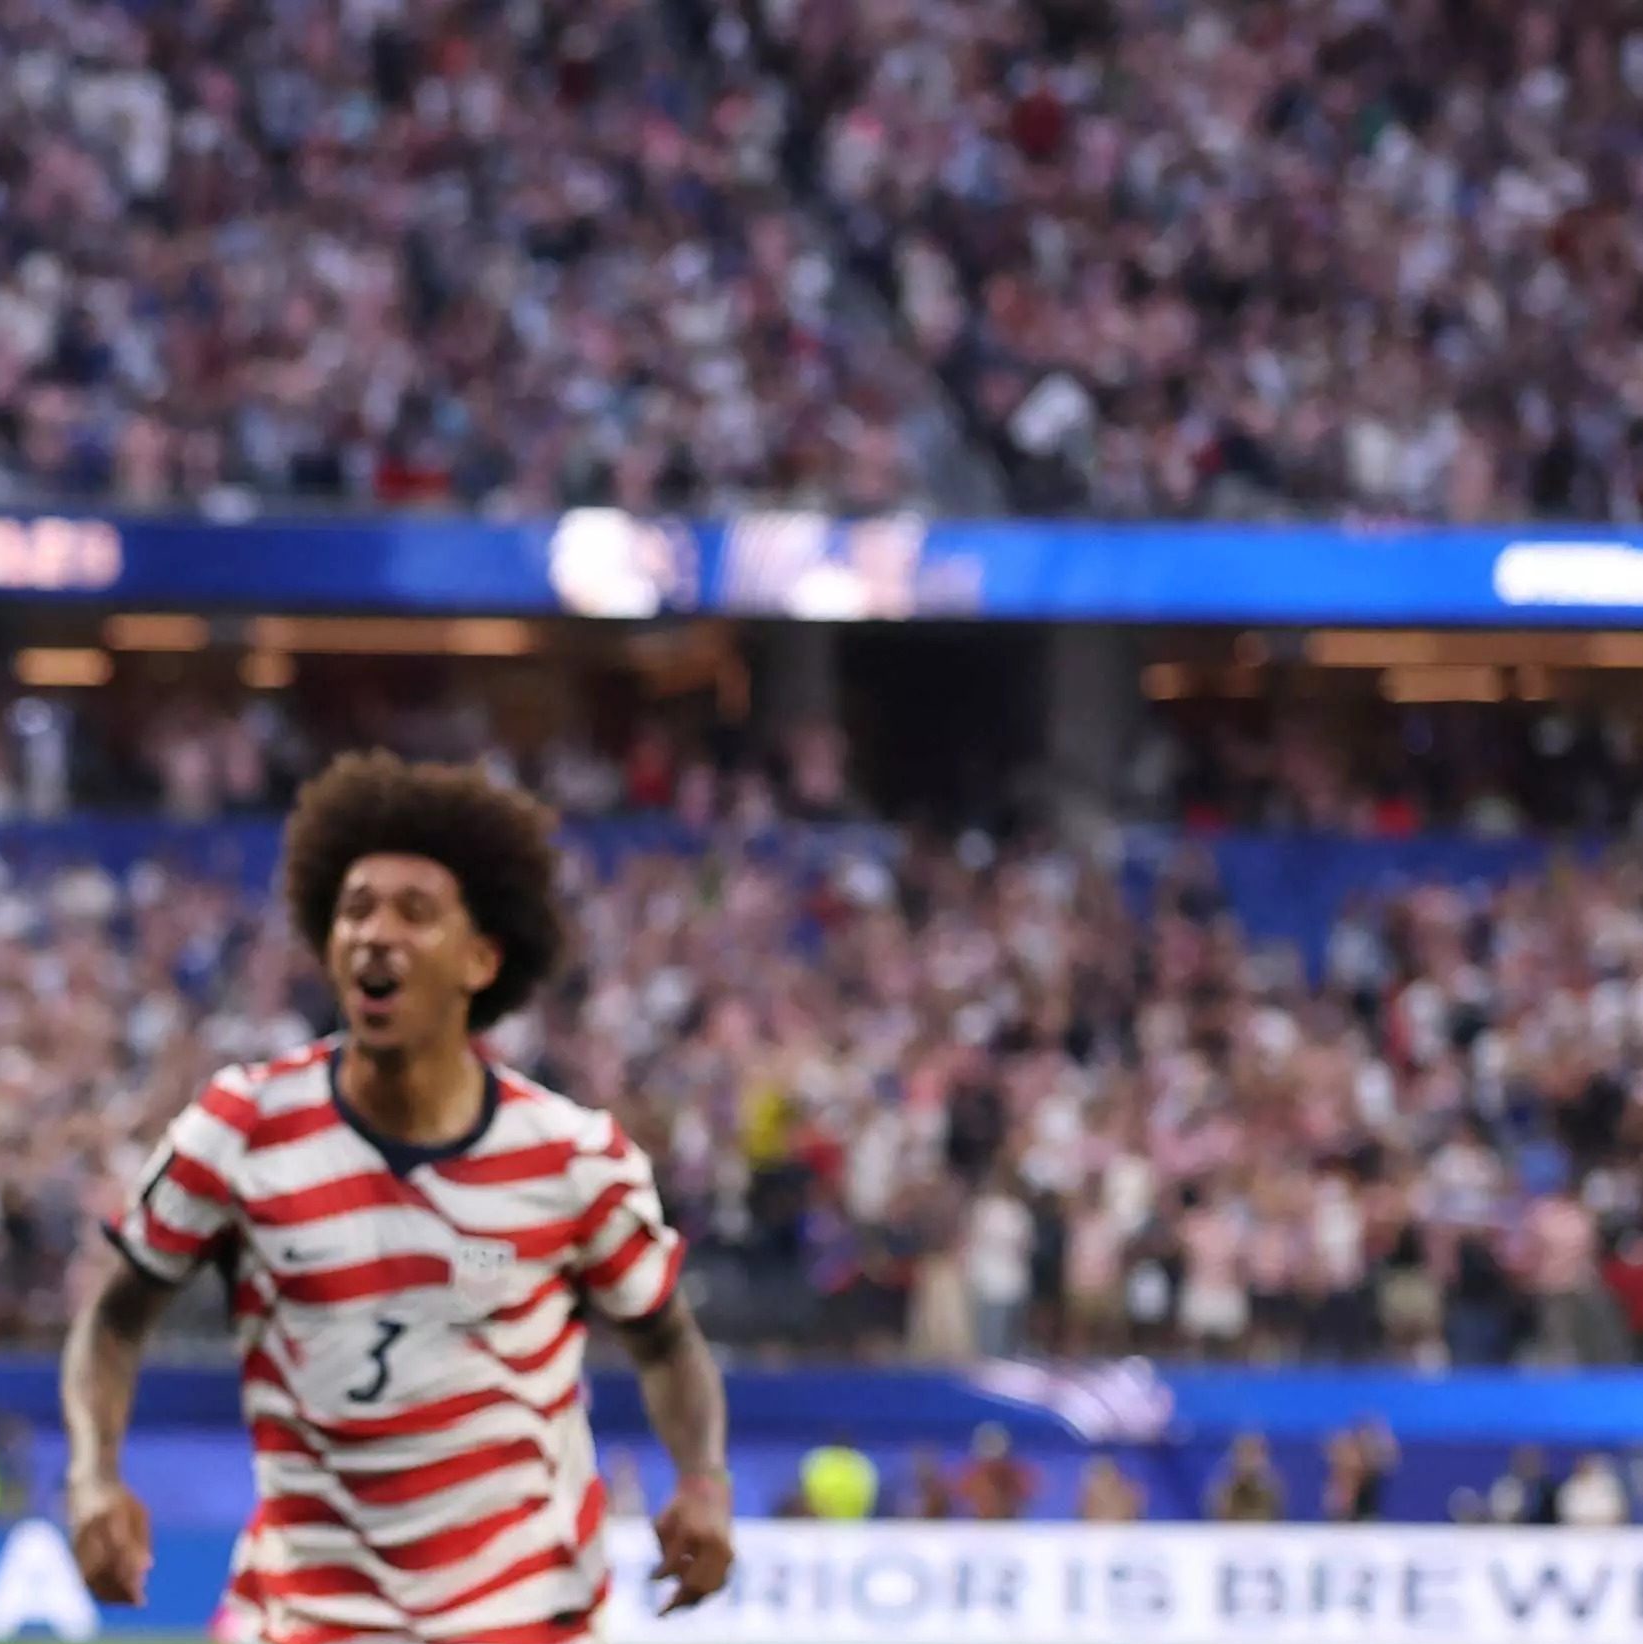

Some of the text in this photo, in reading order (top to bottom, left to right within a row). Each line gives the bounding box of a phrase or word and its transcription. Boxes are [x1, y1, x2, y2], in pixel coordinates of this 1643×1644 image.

[345, 1318, 409, 1404] 3
[644, 1553, 1028, 1624] RIOR
[1211, 1555, 1643, 1622] BREW
